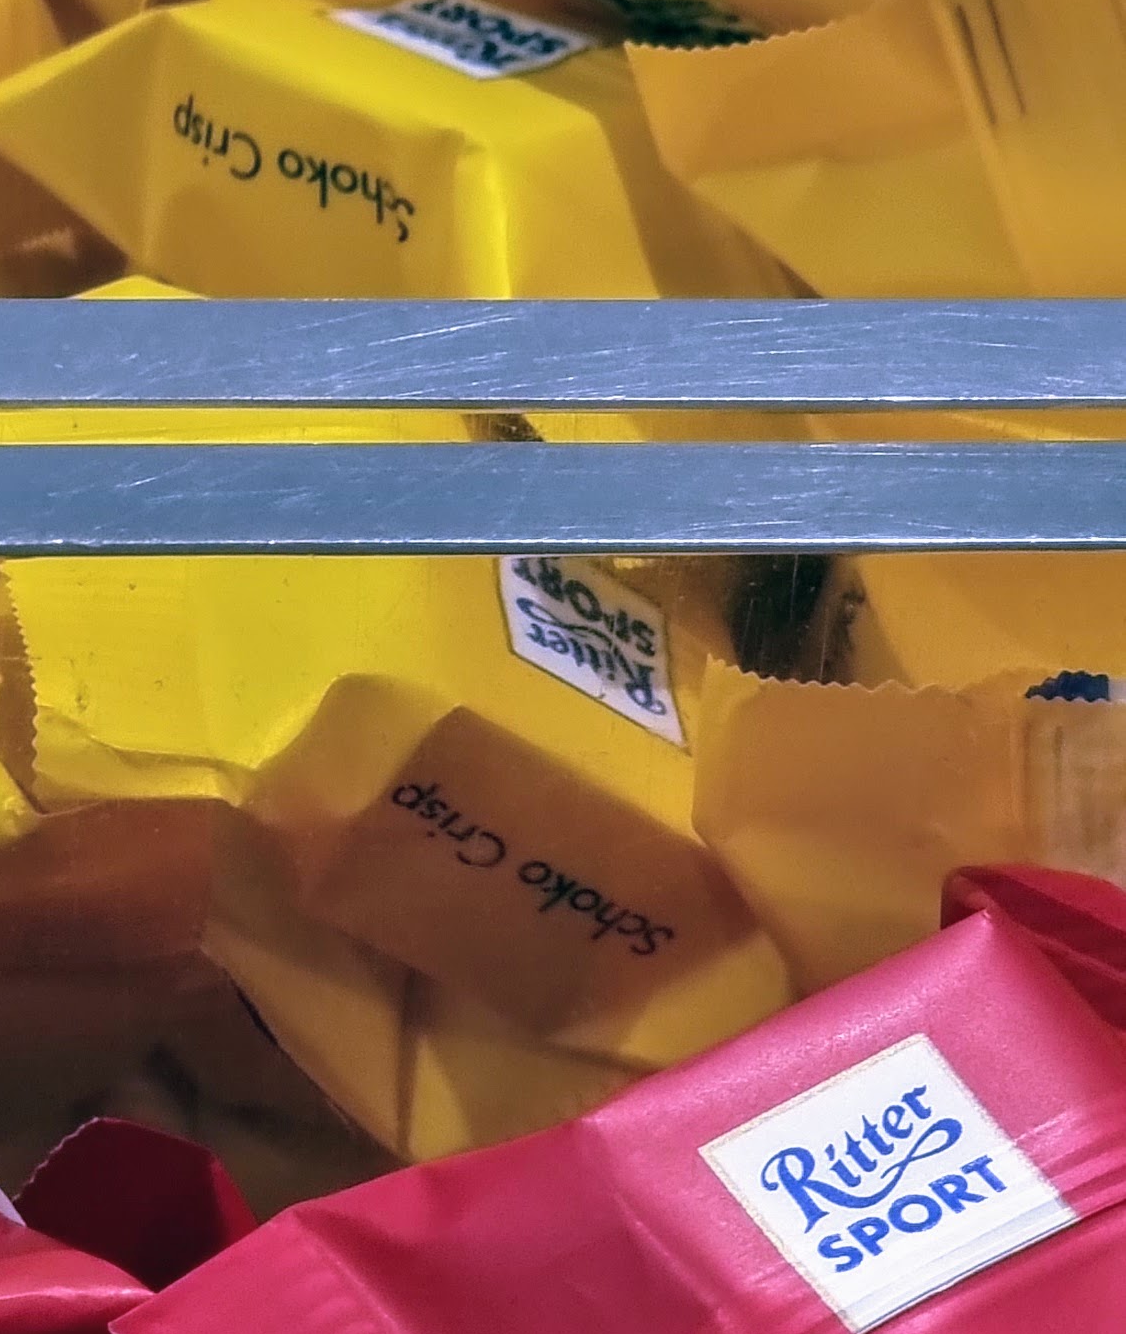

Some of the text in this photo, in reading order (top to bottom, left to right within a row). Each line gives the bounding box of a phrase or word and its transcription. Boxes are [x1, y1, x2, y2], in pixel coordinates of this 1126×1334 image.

[173, 95, 417, 244] Schoko Crisp
[515, 597, 667, 715] Ritter
[392, 782, 673, 957] Schoko Crisp
[761, 1083, 963, 1233] Ritter
[817, 1155, 1007, 1273] SPORT
